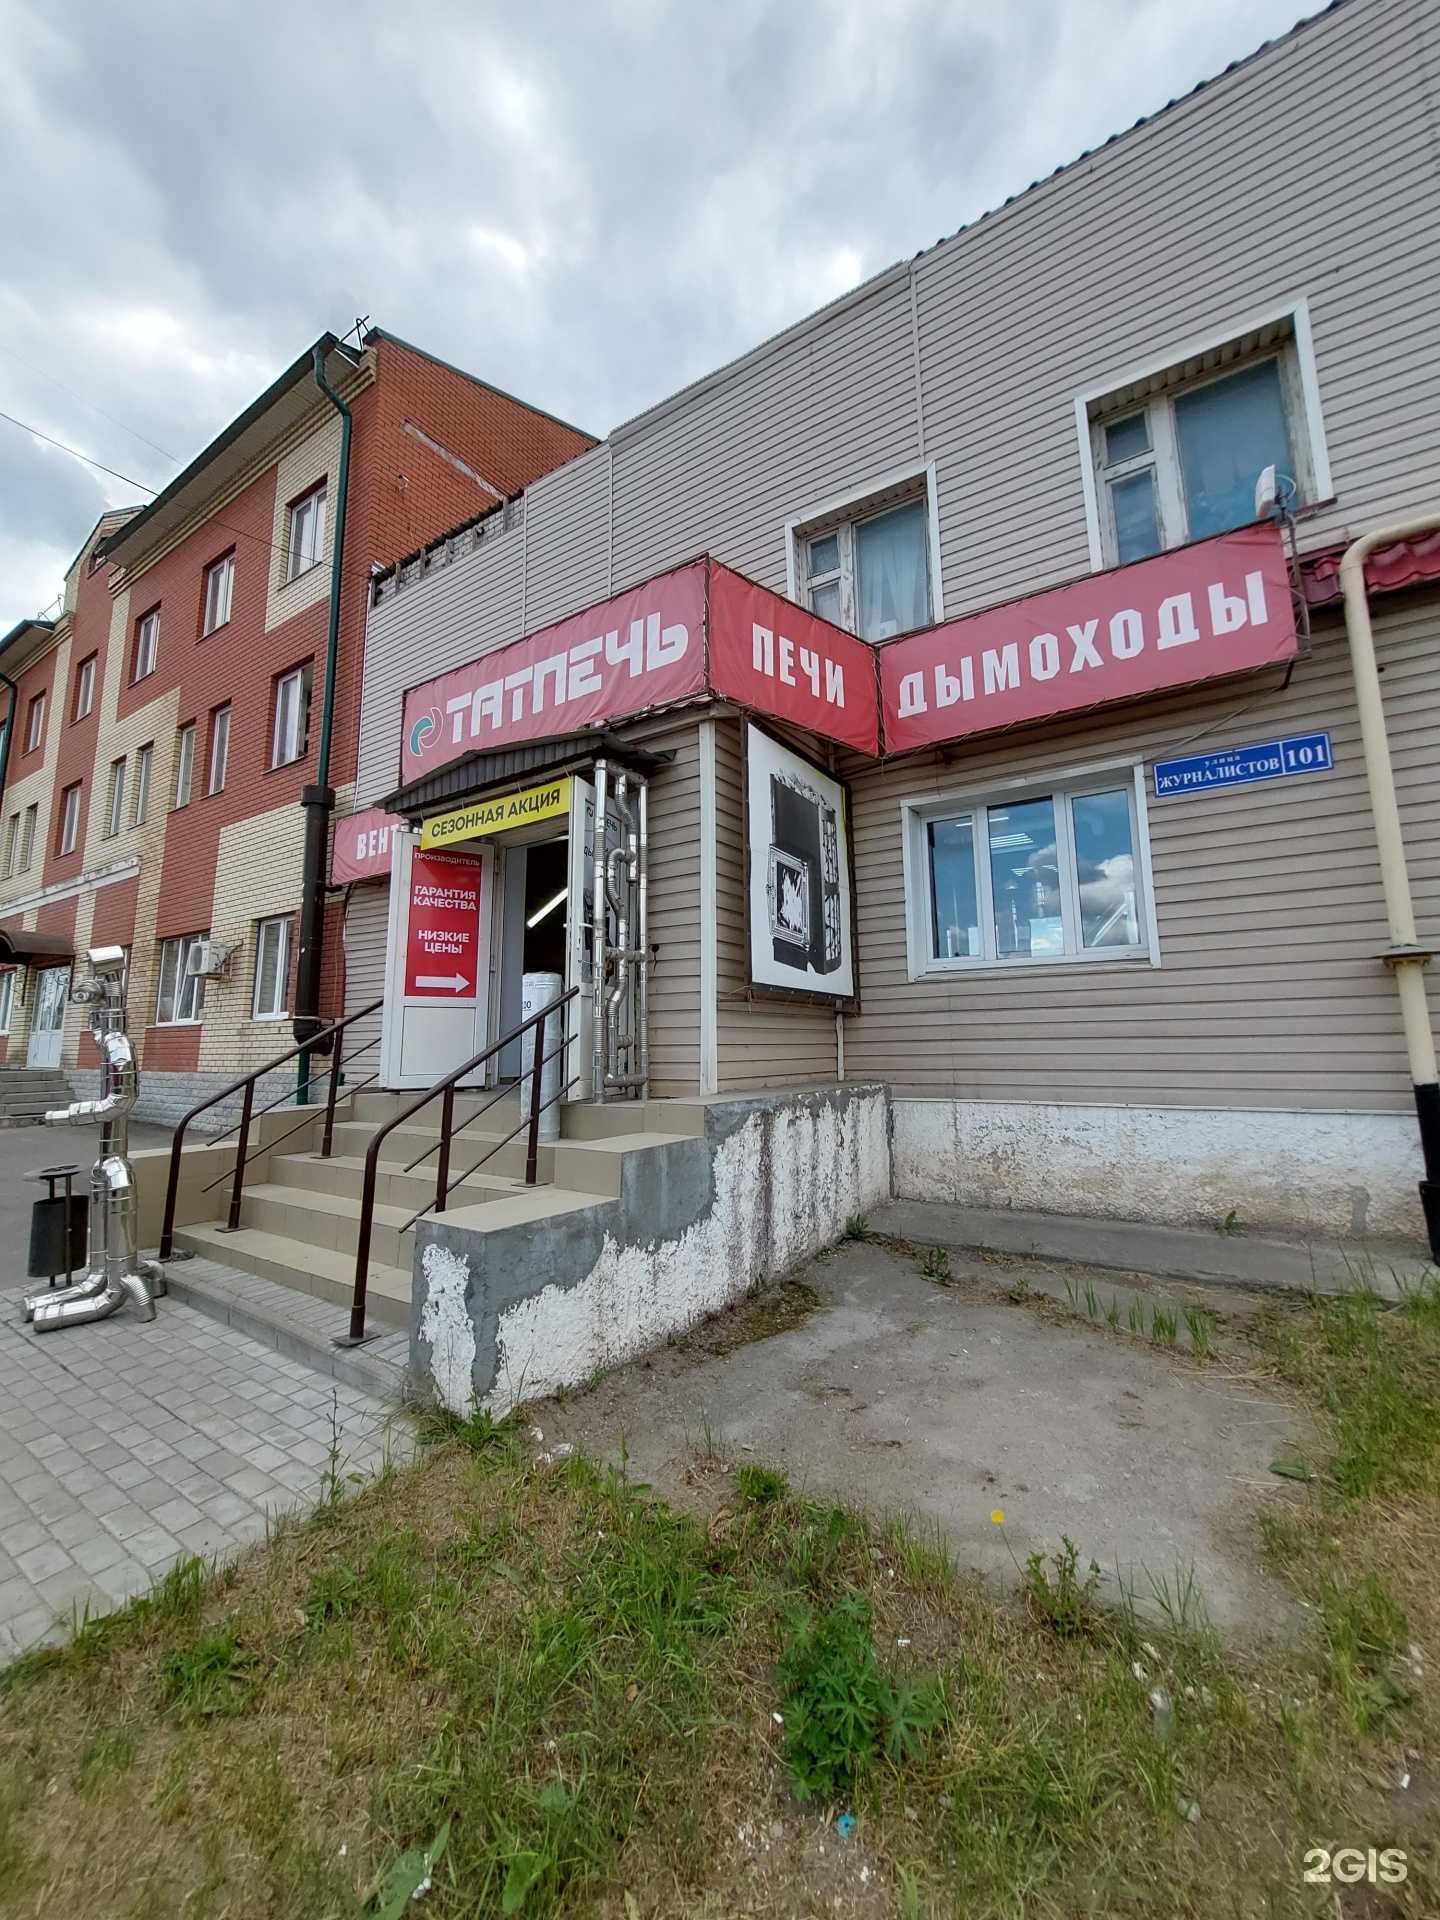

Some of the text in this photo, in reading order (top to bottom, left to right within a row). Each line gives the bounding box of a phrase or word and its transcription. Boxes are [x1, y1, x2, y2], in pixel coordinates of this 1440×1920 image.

[897, 570, 1268, 718] ДЫМОХОДЫ
[447, 611, 689, 743] ТАТПЕЧЬ
[752, 622, 845, 708] ПЕЧИ
[1158, 745, 1326, 789] ЖУРНАЛИСТОВ 101
[1204, 754, 1241, 768] улица
[431, 788, 560, 838] СЕЗОННАЯ АКЦИЯ
[356, 823, 399, 861] ВЕН
[414, 852, 480, 866] ПРОИЗВОДИТЕЛЬ
[414, 896, 477, 910] КАЧЕСТВА
[415, 886, 476, 900] ГАРАНТИЯ
[418, 929, 470, 943] НИЗКИЕ
[424, 942, 463, 954] ЦЕНЫ
